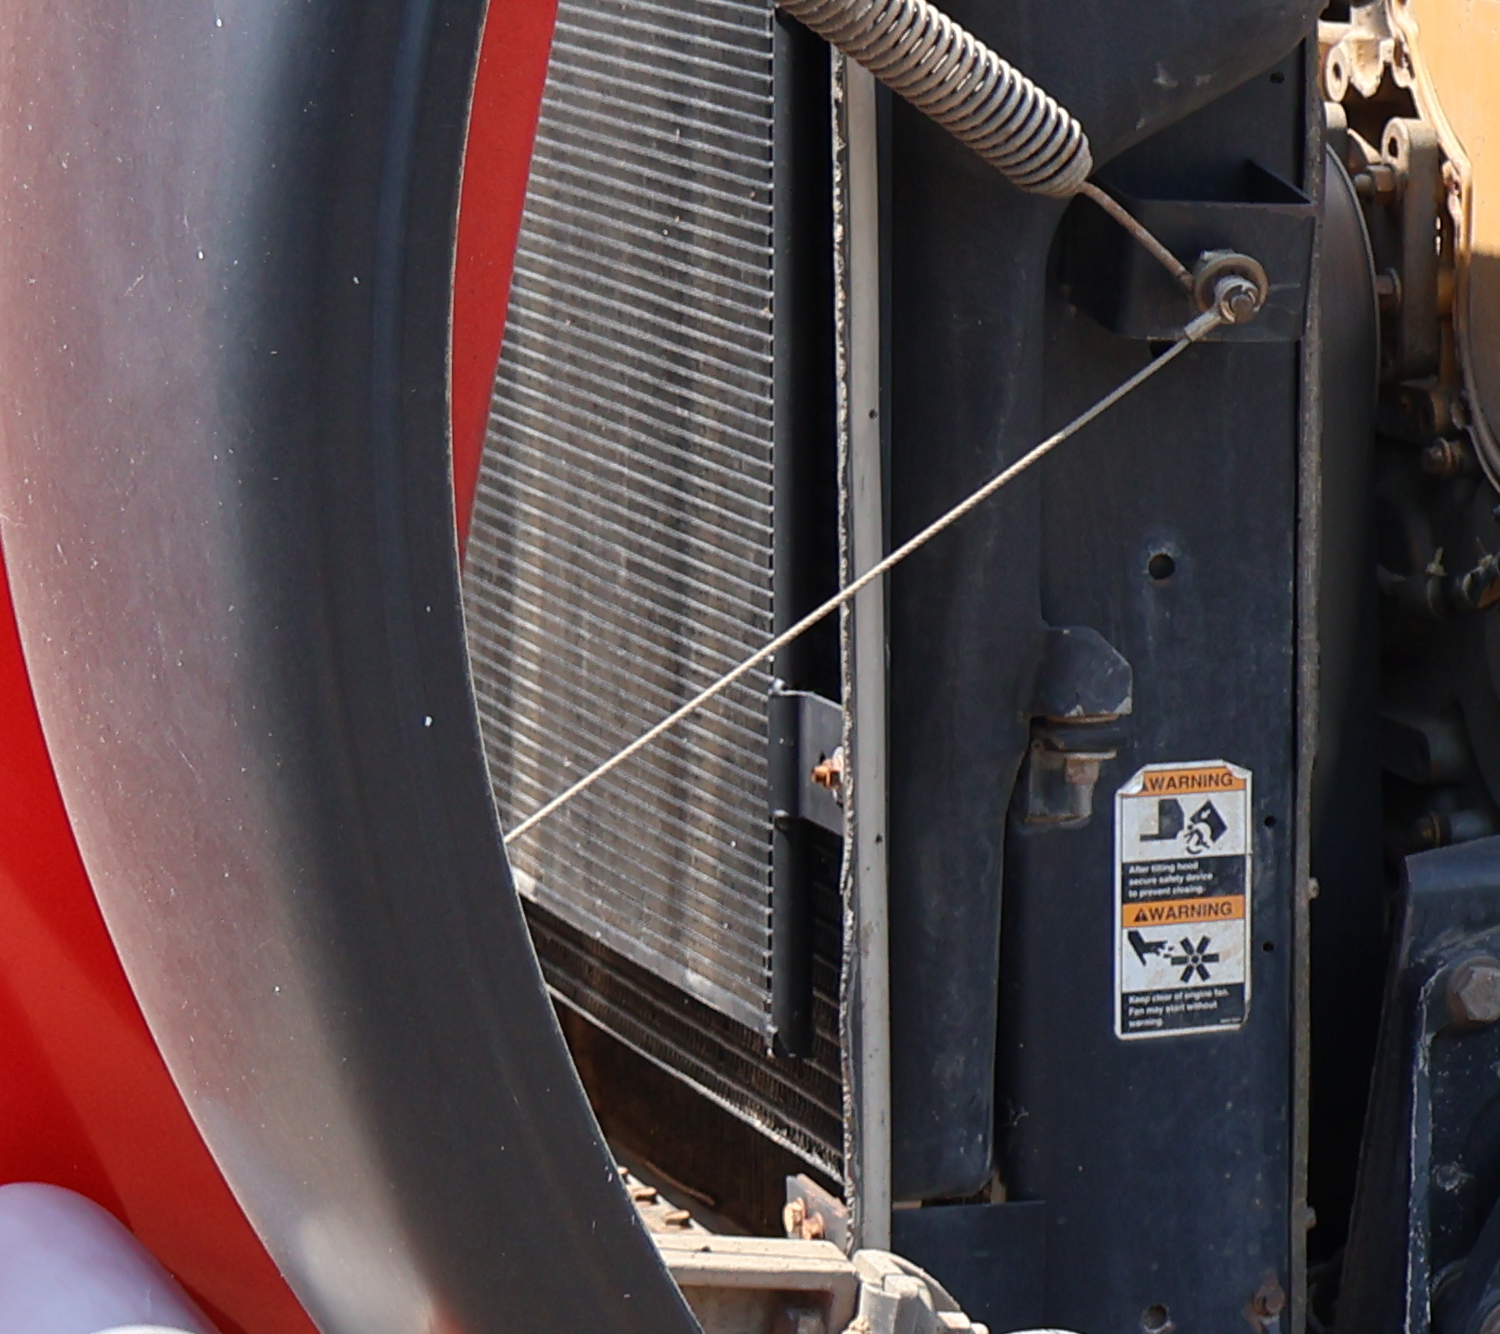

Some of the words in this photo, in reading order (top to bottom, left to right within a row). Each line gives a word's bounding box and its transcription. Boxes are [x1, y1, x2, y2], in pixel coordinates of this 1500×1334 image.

[1149, 771, 1233, 790] WARNING
[1177, 861, 1198, 871] hood
[1129, 876, 1157, 887] secure
[1139, 886, 1170, 899] prevent
[1150, 902, 1232, 921] WARNING
[1128, 995, 1151, 1005] Keep
[1128, 1007, 1145, 1016] Fan
